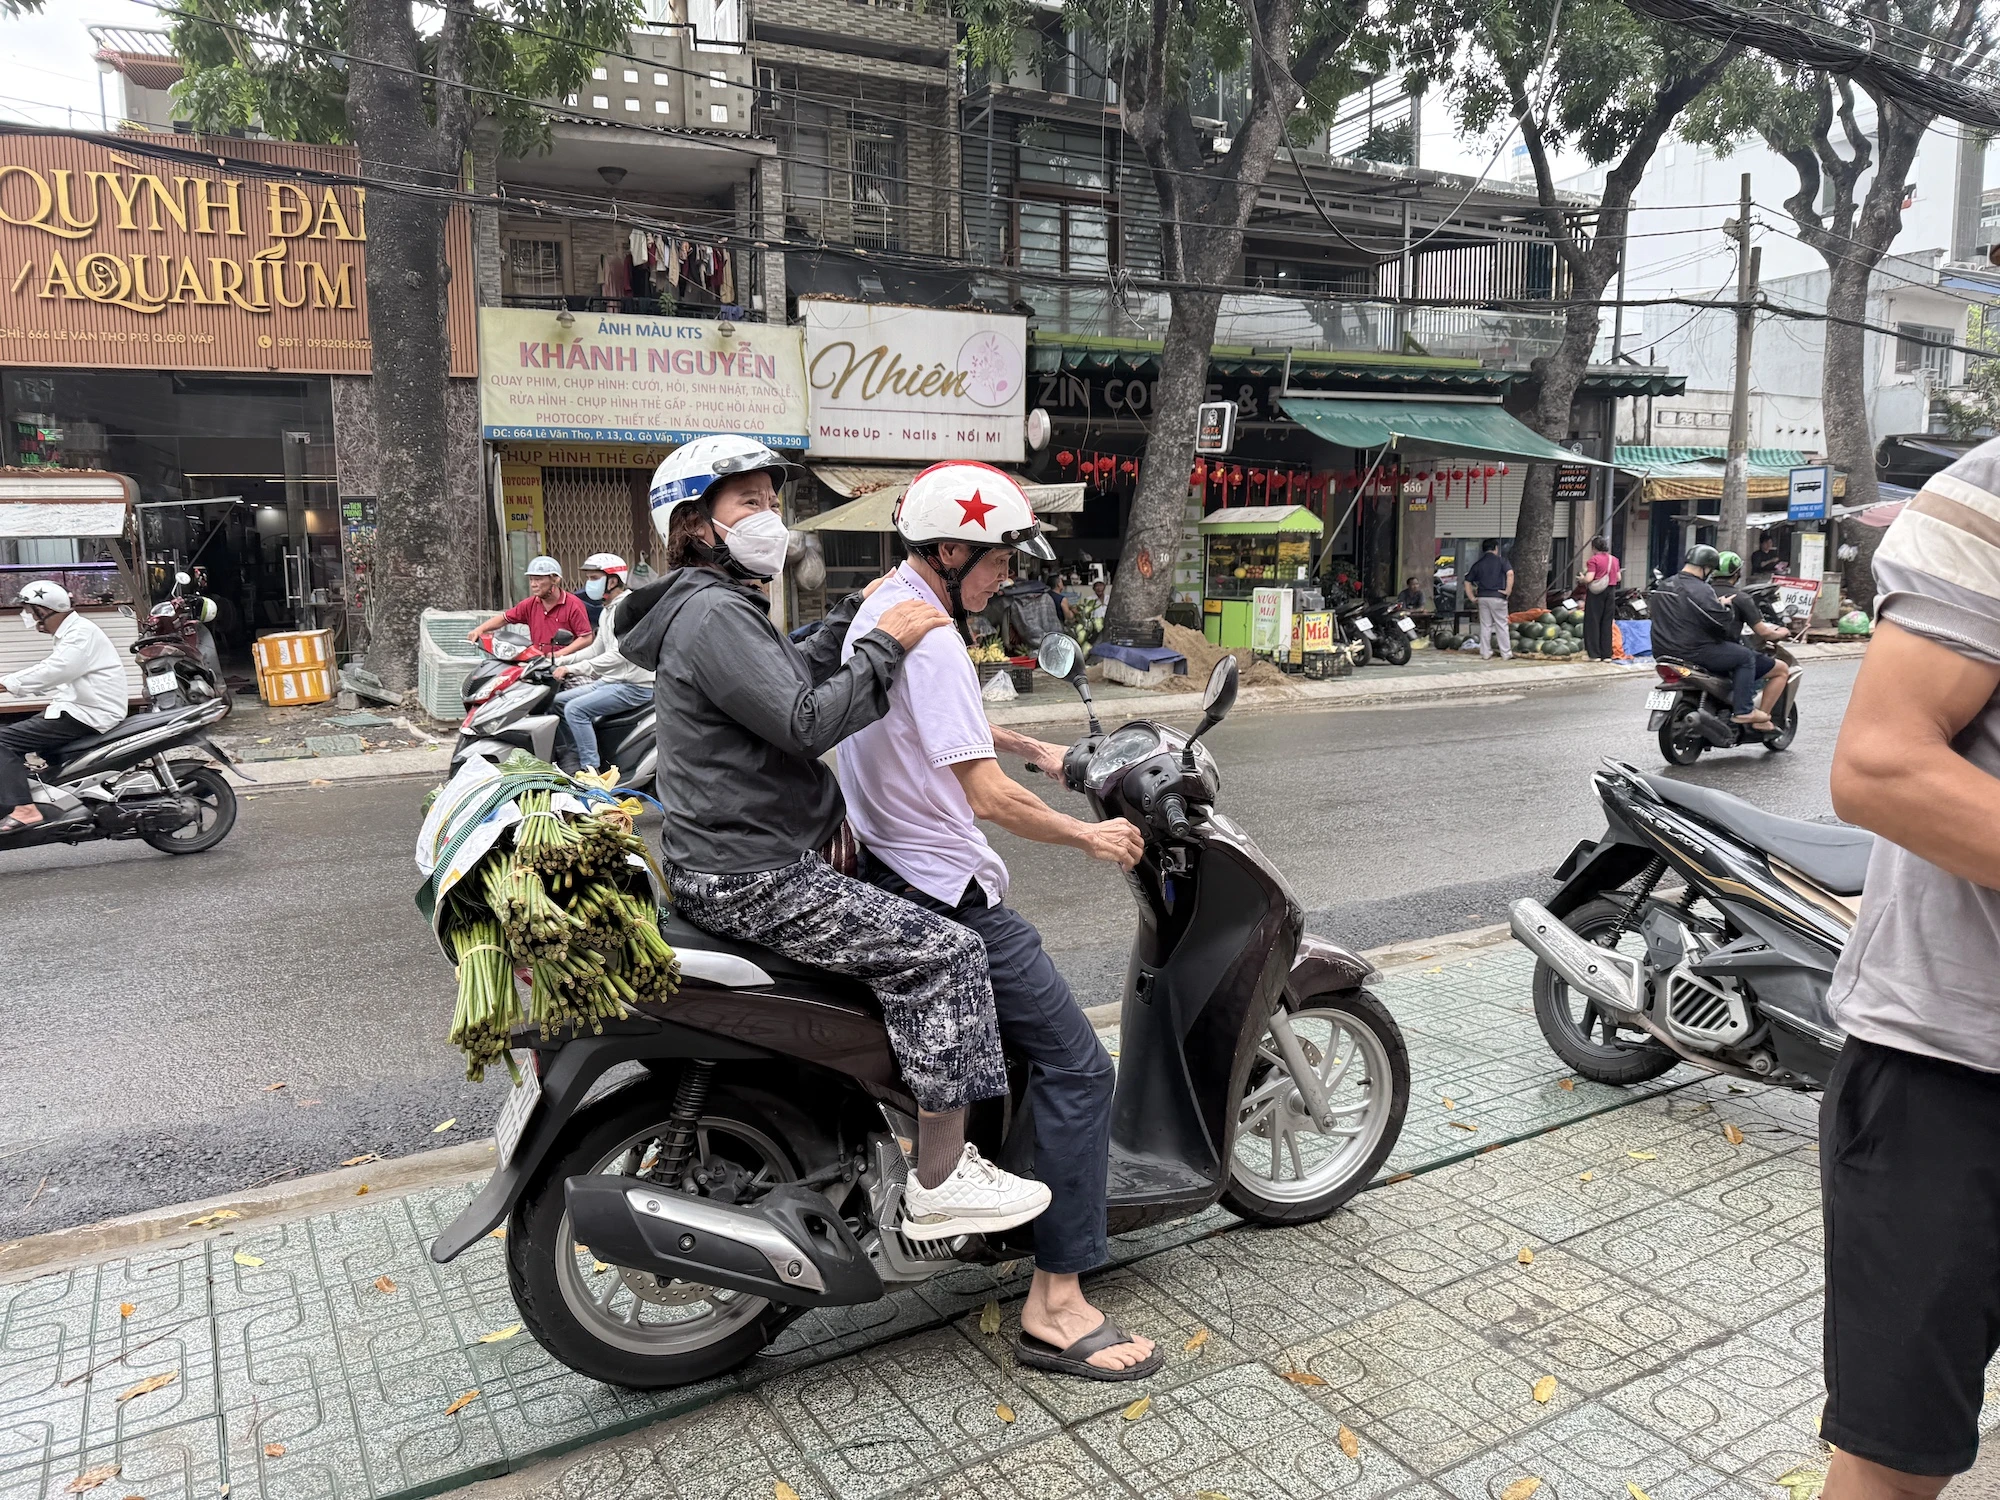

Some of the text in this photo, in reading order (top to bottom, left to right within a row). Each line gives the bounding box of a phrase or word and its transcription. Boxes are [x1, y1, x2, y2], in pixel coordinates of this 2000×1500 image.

[0, 152, 246, 239] QUỲNH
[28, 329, 50, 340] 666
[53, 327, 67, 341] LÊ
[69, 328, 98, 342] VĂN
[100, 331, 127, 345] THỌ
[130, 331, 151, 343] P13
[190, 330, 215, 345] VẤP
[598, 317, 703, 339] ẢNH MÀU KTS
[277, 337, 302, 348] SĐT:
[520, 337, 776, 379] KHÁNH NGUYỄN
[809, 341, 972, 401] Nhiên
[491, 374, 523, 387] QUAY
[526, 376, 560, 389] PHIM,
[563, 378, 594, 391] CHỤP
[598, 376, 629, 390] HÌNH:
[632, 378, 663, 393] CƯỚI,
[666, 379, 689, 394] HỎI,
[692, 382, 716, 394] SINH
[719, 383, 749, 397] NHẬT,
[752, 386, 779, 398] TANG
[1038, 376, 1091, 408] ZIN
[1239, 385, 1258, 413] &
[509, 391, 535, 405] RỬA
[538, 392, 567, 406] HÌNH
[577, 396, 607, 410] CHỤP
[611, 395, 638, 409] HÌNH
[642, 396, 662, 410] THẺ
[665, 396, 686, 411] GẤP
[696, 401, 724, 414] PHỤC
[727, 400, 745, 413] HỒI
[749, 400, 770, 414] ẢNH
[773, 402, 786, 415] CŨ
[536, 412, 604, 425] PHOTOCOPY
[615, 410, 645, 426] THIẾT
[648, 413, 660, 427] KẾ
[670, 417, 681, 427] IN
[702, 416, 741, 430] QUẢNG
[744, 418, 765, 430] CÁO
[493, 429, 511, 438] ĐC:
[514, 429, 533, 438] 664
[536, 428, 547, 438] Lê
[596, 431, 605, 440] P.
[608, 432, 621, 441] 13,
[624, 433, 635, 441] Q.
[638, 432, 652, 441] Gò
[655, 431, 673, 443] Vấp
[500, 450, 542, 464] CHỤP
[548, 448, 591, 463] HÌNH
[596, 449, 627, 465] THẺ
[506, 494, 533, 505] IN MÀU
[1159, 553, 1170, 562] 10
[1306, 621, 1329, 641] Mía
[1628, 805, 1656, 824] AIR
